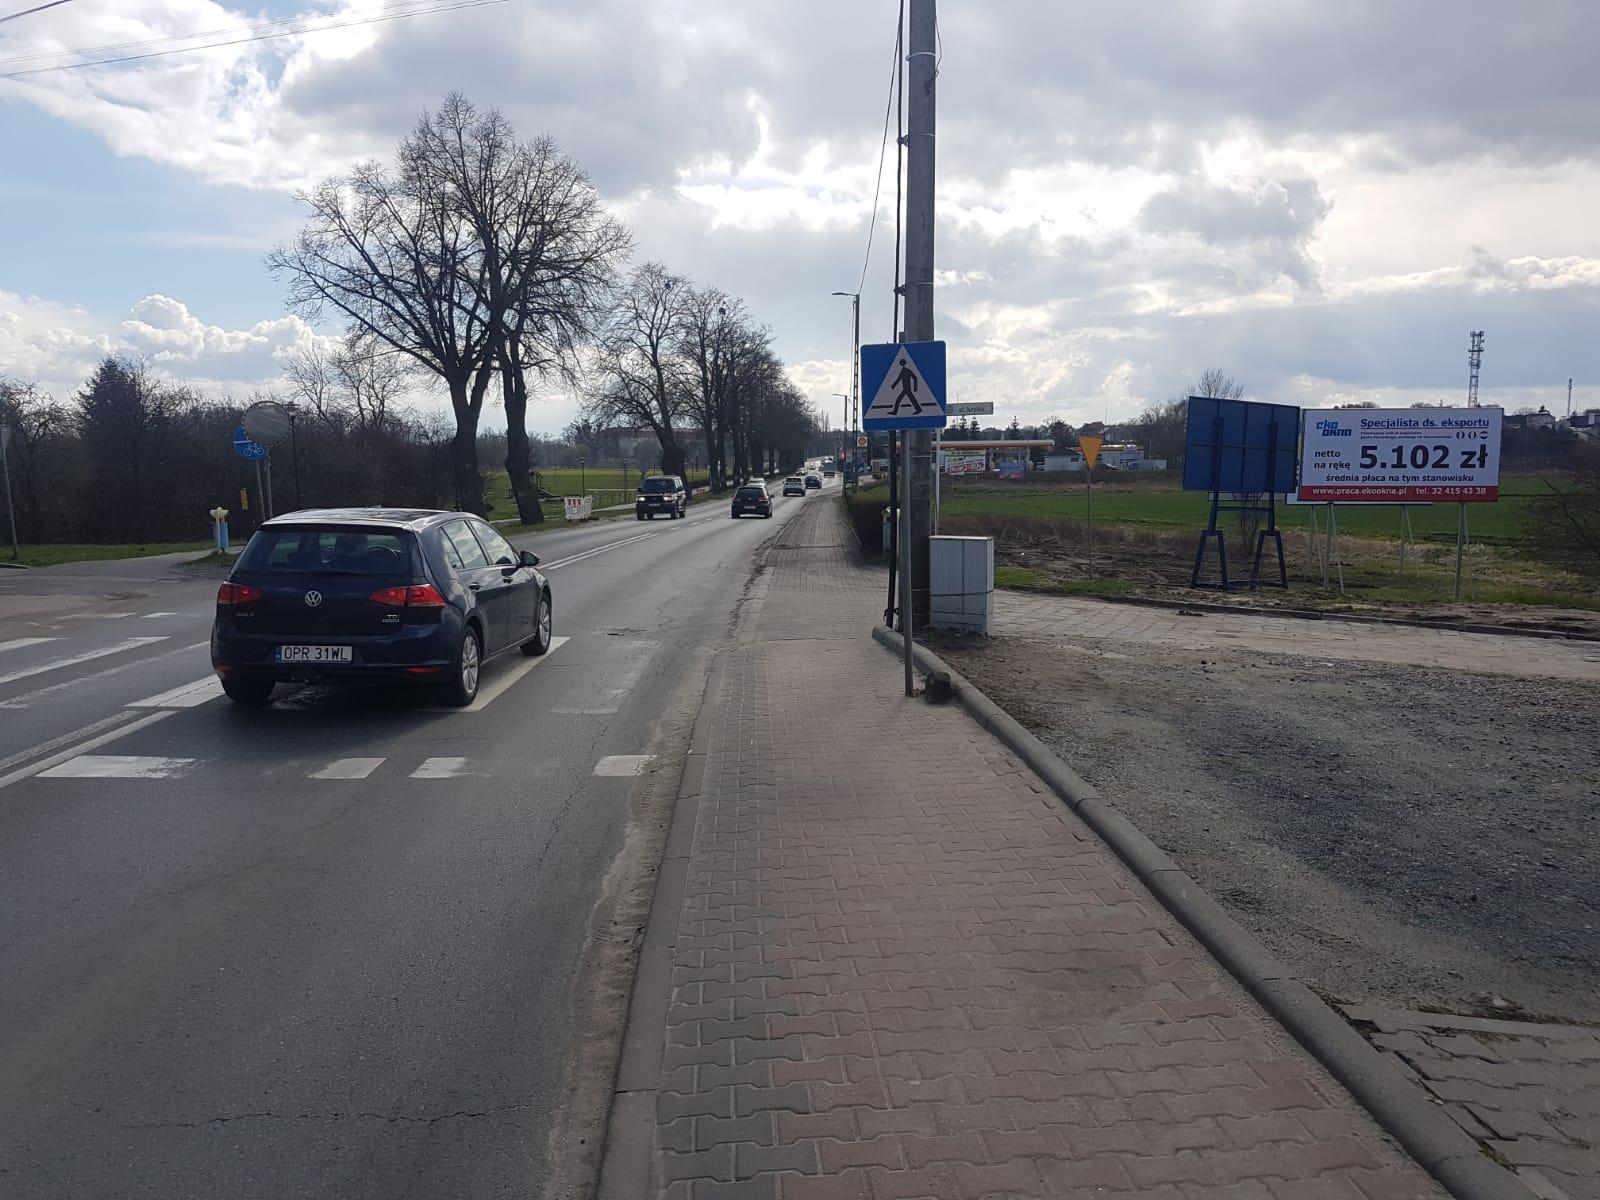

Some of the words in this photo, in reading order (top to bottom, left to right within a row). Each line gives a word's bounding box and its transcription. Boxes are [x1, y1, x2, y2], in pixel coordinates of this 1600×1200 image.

[1360, 418, 1419, 428] Specjalista
[1422, 418, 1438, 427] ds.
[1441, 418, 1489, 428] eksportu
[1314, 449, 1341, 458] netto
[1360, 445, 1449, 469] 5.102
[1460, 443, 1488, 469] zł
[1314, 461, 1326, 469] na
[1328, 460, 1351, 471] rękę
[1326, 473, 1359, 482] średnia
[1361, 473, 1386, 483] płaca
[1388, 474, 1400, 482] na
[1402, 474, 1420, 483] tym
[1422, 473, 1474, 482] stanowisku
[1312, 487, 1407, 496] www.praca.ekookna.pl
[1416, 487, 1430, 495] tel.
[1431, 487, 1443, 495] 32
[1444, 487, 1461, 495] 415
[1462, 487, 1473, 495] 43
[1474, 487, 1487, 495] 38
[284, 646, 309, 660] OPR
[314, 646, 350, 660] 31WL
